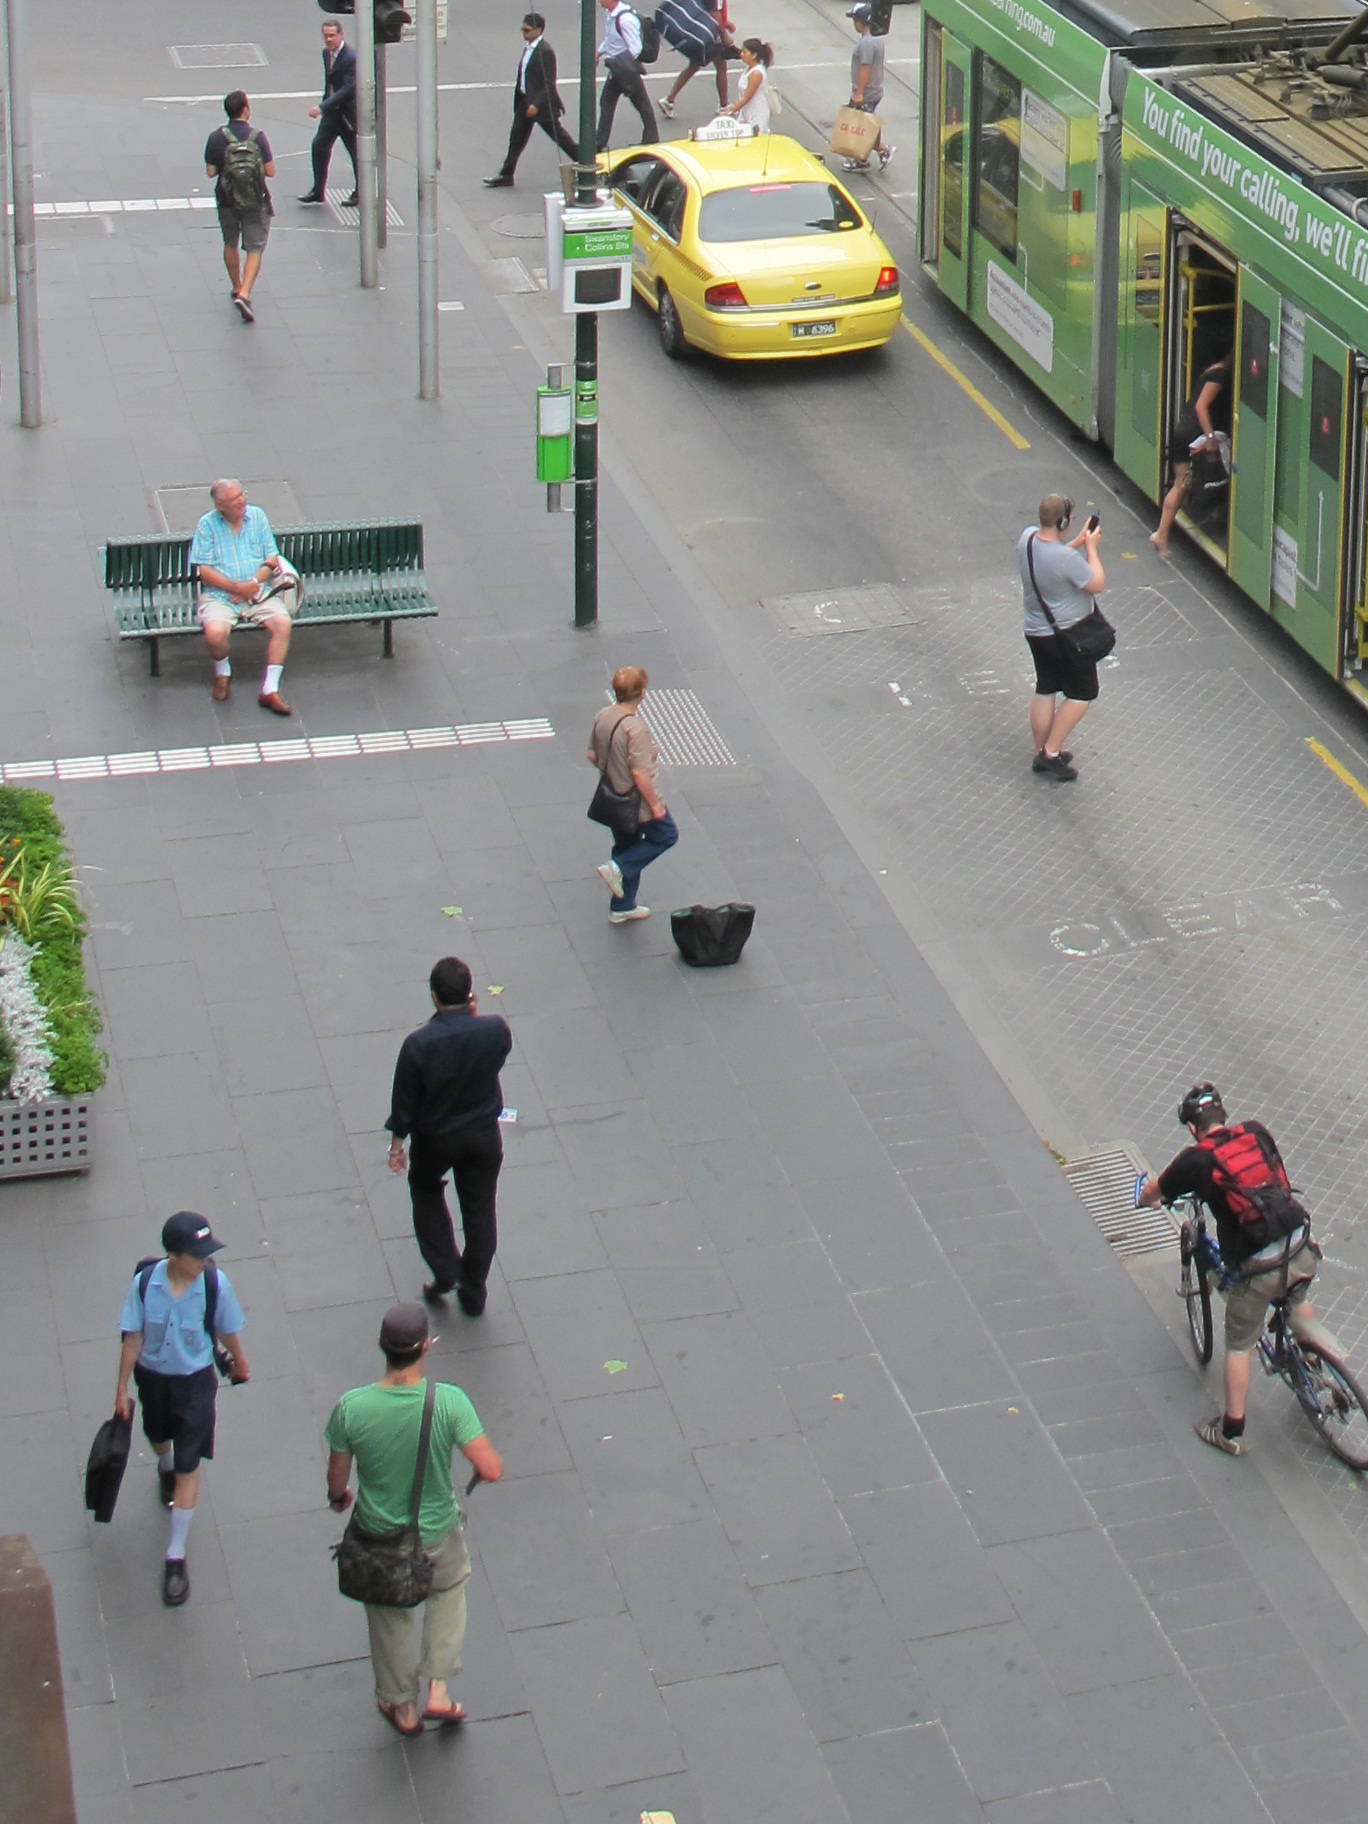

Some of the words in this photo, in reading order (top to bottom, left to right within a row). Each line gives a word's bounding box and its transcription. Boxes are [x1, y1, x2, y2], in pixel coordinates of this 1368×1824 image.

[715, 120, 735, 129] TAXI
[1142, 87, 1170, 138] You
[1169, 109, 1204, 161] find
[1200, 140, 1241, 188] your
[1239, 168, 1301, 242] calling,
[1305, 212, 1352, 271] we'll
